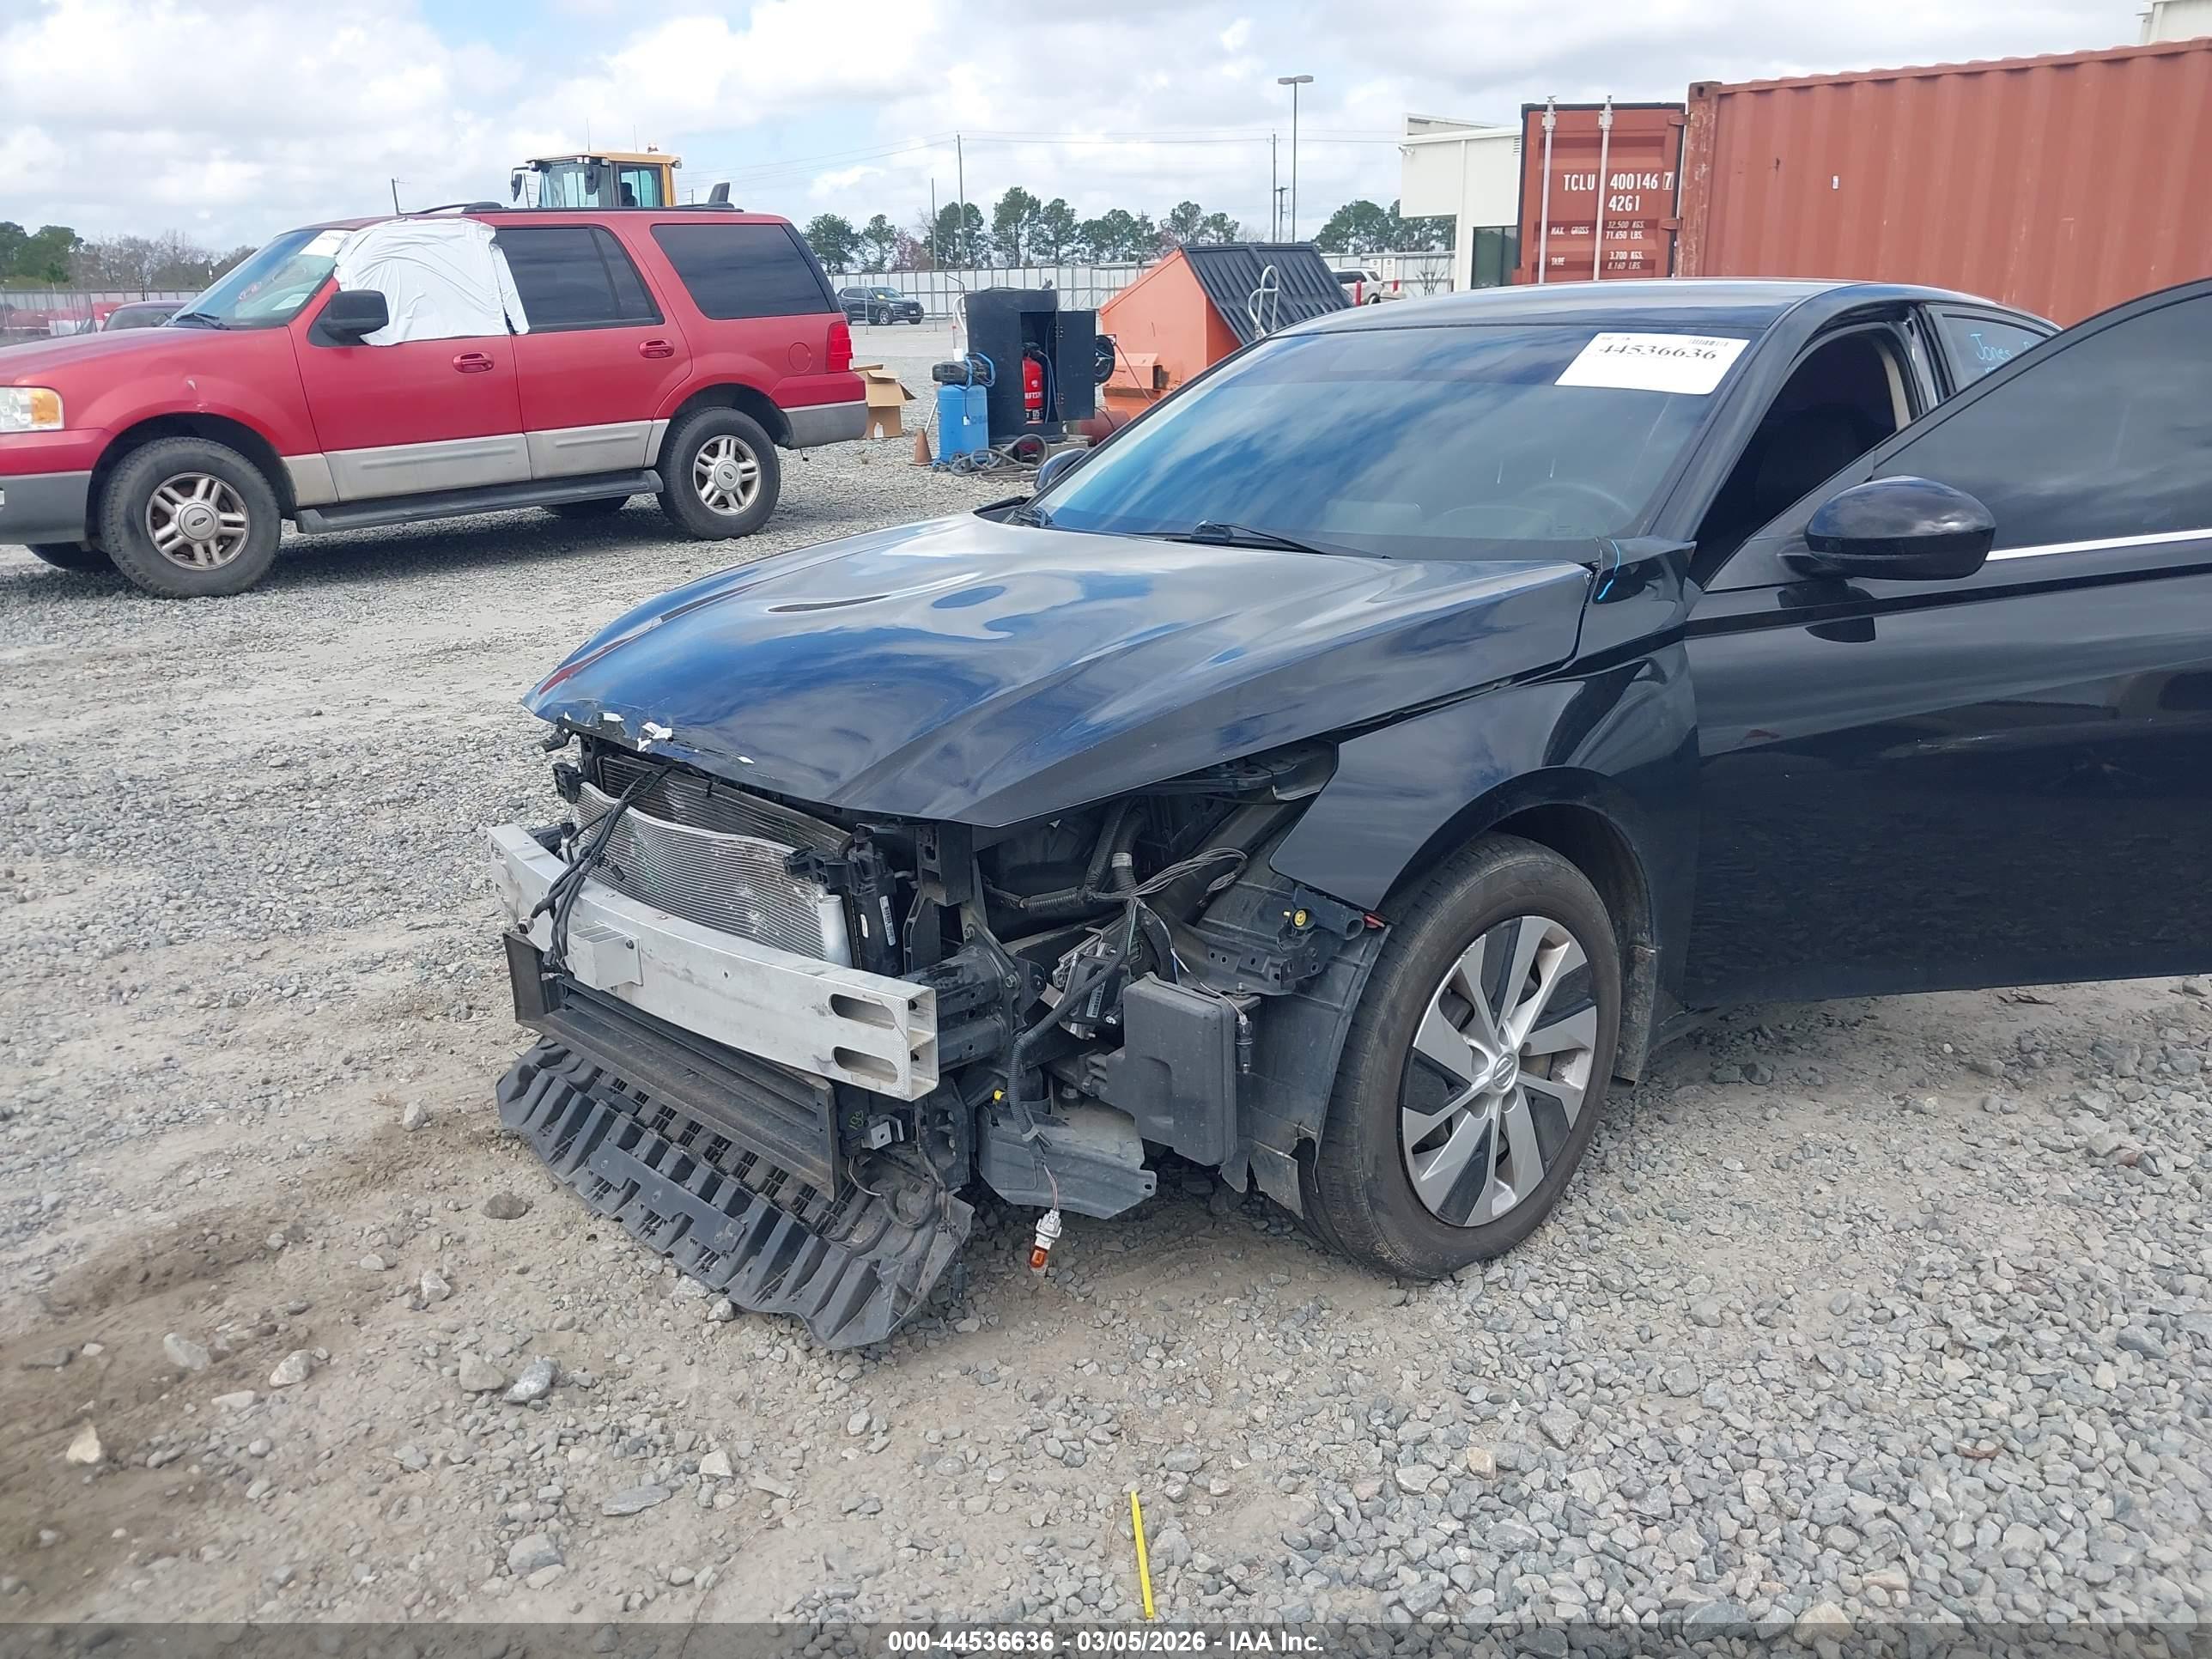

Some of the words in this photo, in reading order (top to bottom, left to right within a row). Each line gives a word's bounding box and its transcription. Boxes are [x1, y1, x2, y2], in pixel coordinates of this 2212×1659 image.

[1564, 173, 1595, 191] TCLU
[1610, 173, 1658, 190] 400146
[1608, 195, 1640, 211] 42G1
[1571, 226, 1589, 234] GROSS
[1551, 257, 1565, 265] TARE
[1598, 343, 1717, 360] 44536636
